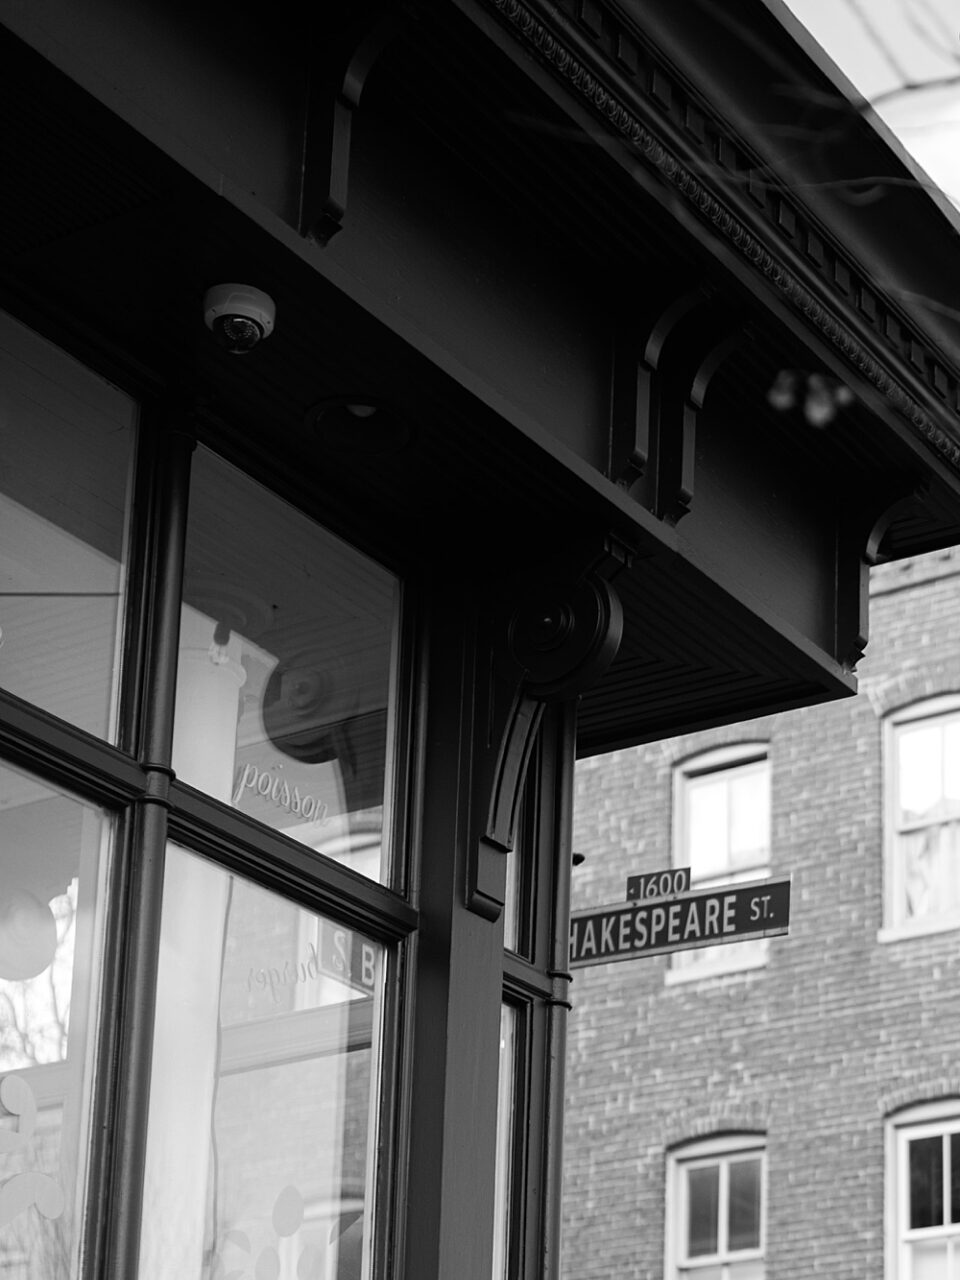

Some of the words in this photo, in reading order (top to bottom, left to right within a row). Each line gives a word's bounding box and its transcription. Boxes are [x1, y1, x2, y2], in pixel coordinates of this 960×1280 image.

[639, 870, 687, 899] 1600
[569, 895, 737, 958] HAKESPEARE
[750, 896, 775, 921] ST.
